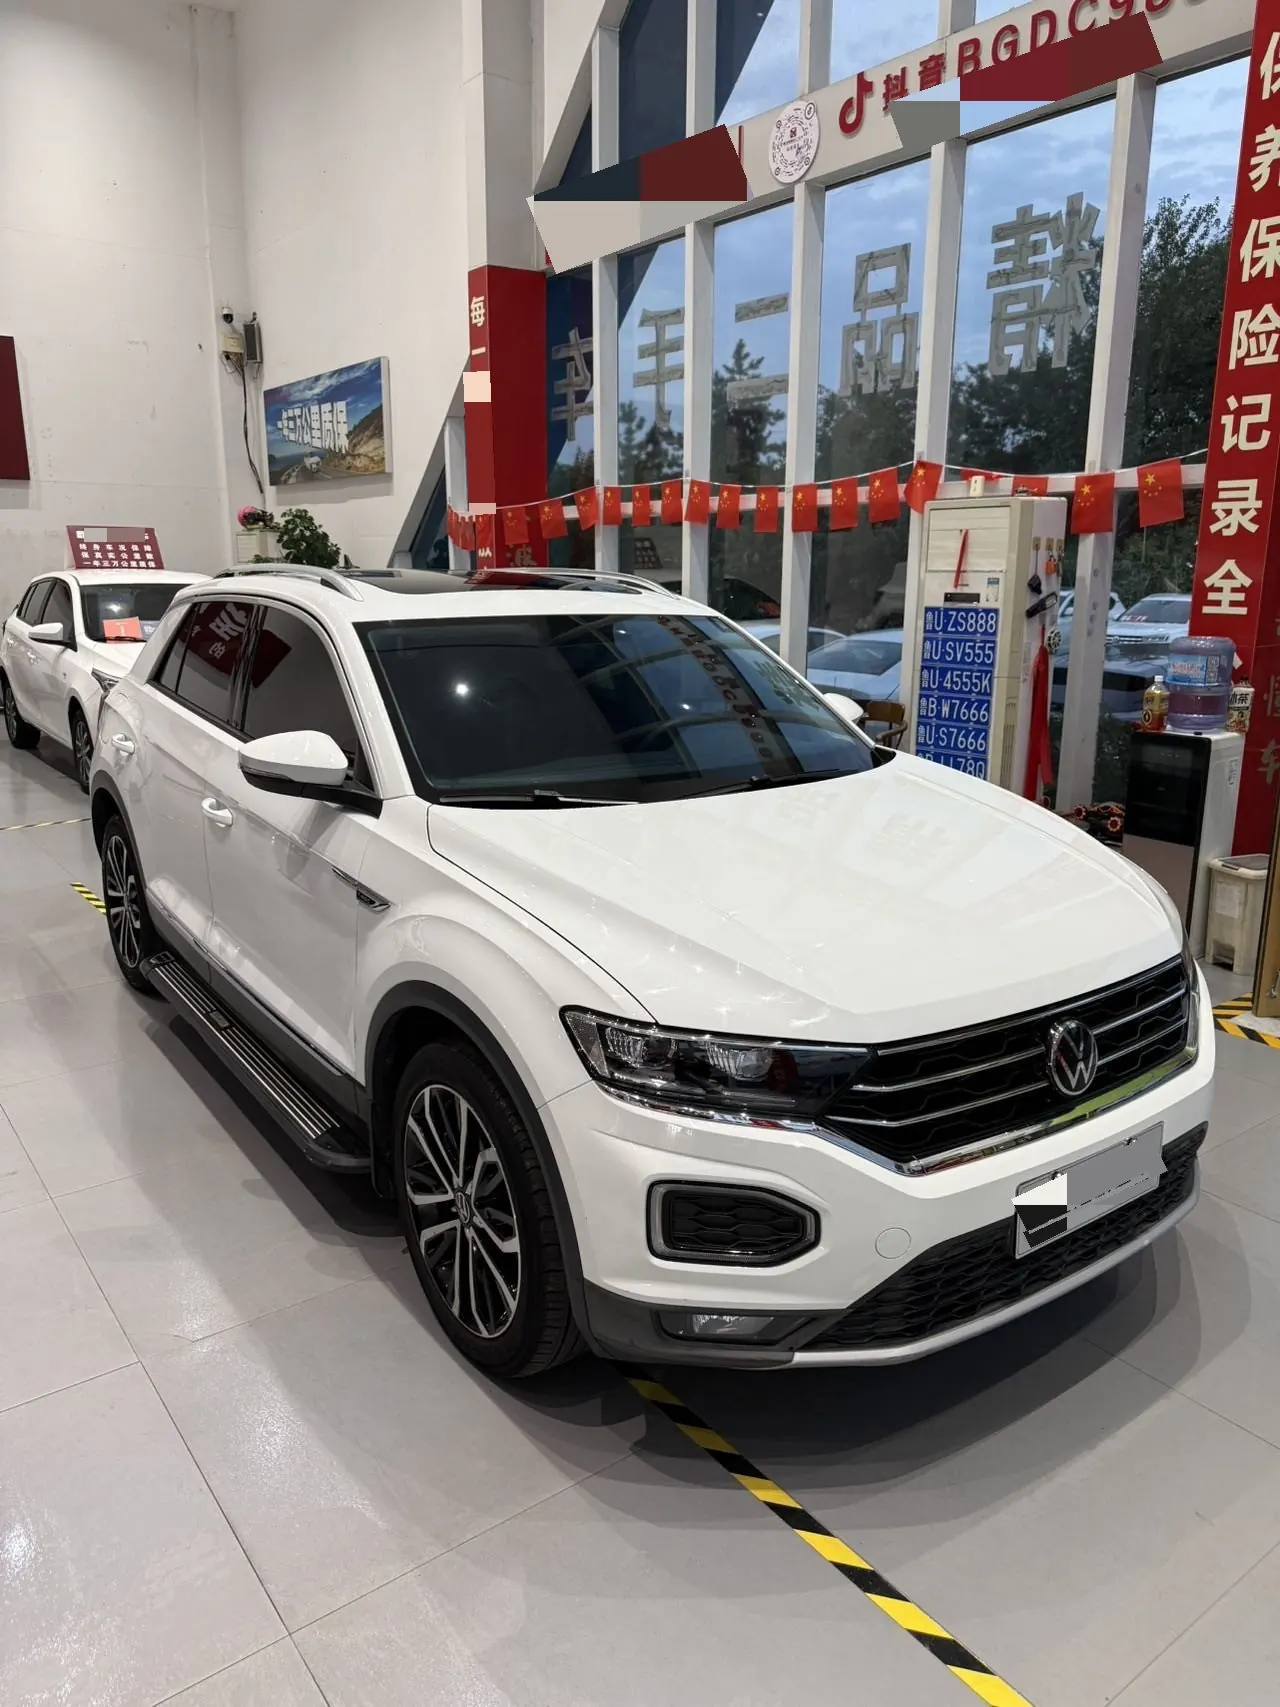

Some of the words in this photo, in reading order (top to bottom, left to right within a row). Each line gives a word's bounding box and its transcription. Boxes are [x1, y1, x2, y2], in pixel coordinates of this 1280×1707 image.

[277, 401, 349, 454] 一年三万公里质保
